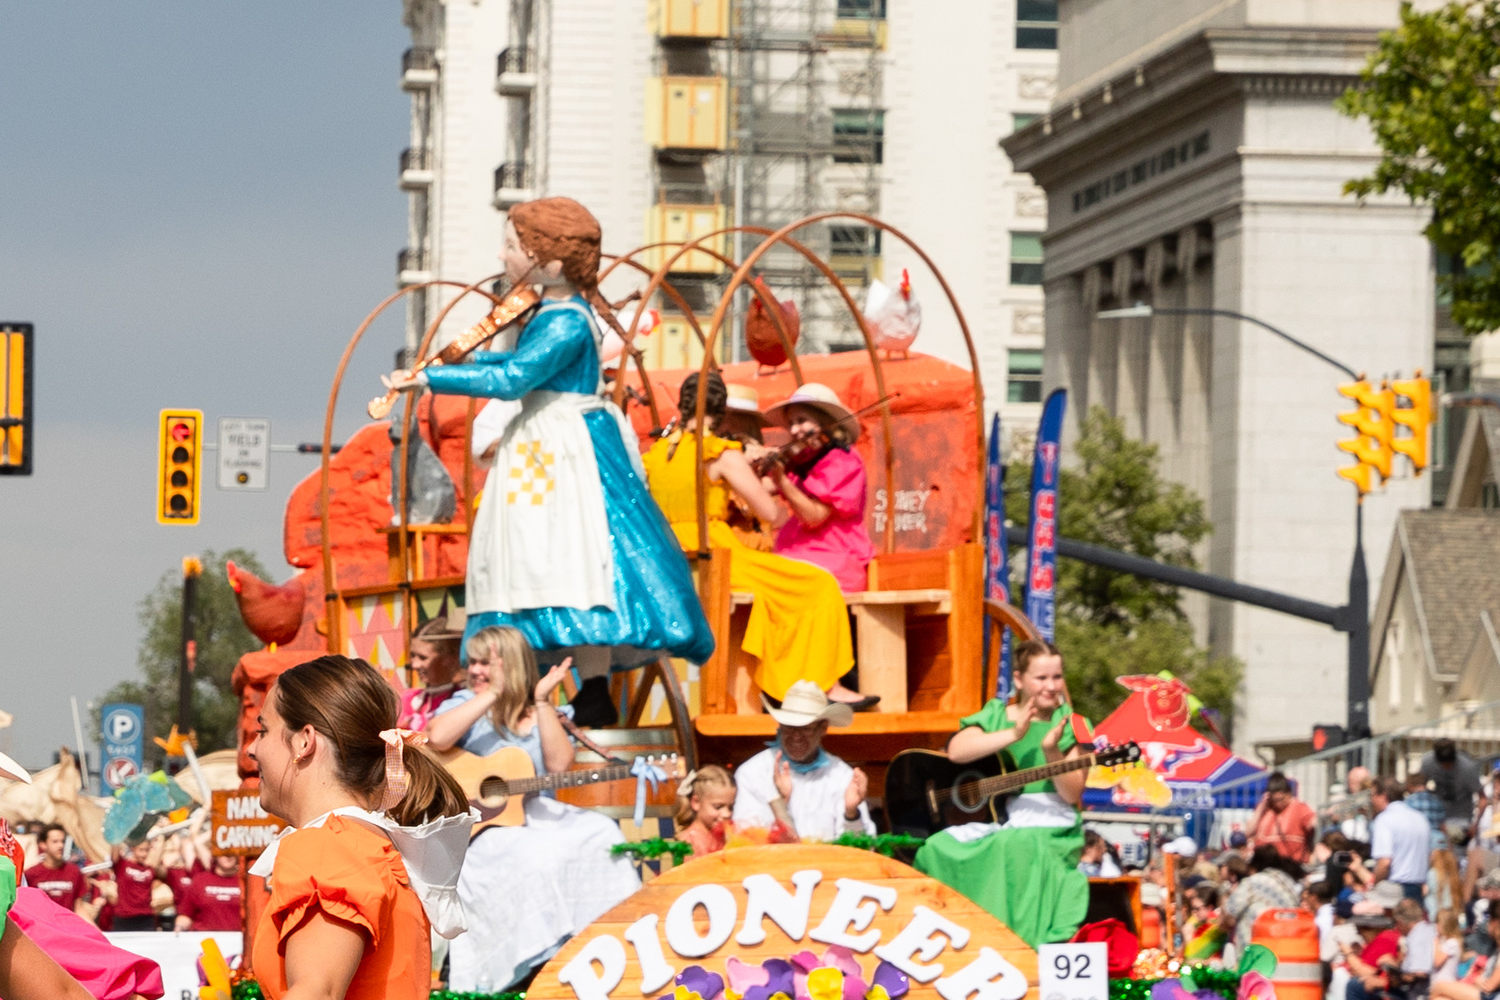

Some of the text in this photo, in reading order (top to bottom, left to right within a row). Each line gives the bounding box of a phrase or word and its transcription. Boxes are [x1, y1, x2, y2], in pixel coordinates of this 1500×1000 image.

[227, 433, 261, 446] YIELD
[113, 714, 134, 739] P
[216, 824, 280, 849] CARVING
[1054, 954, 1092, 980] 92
